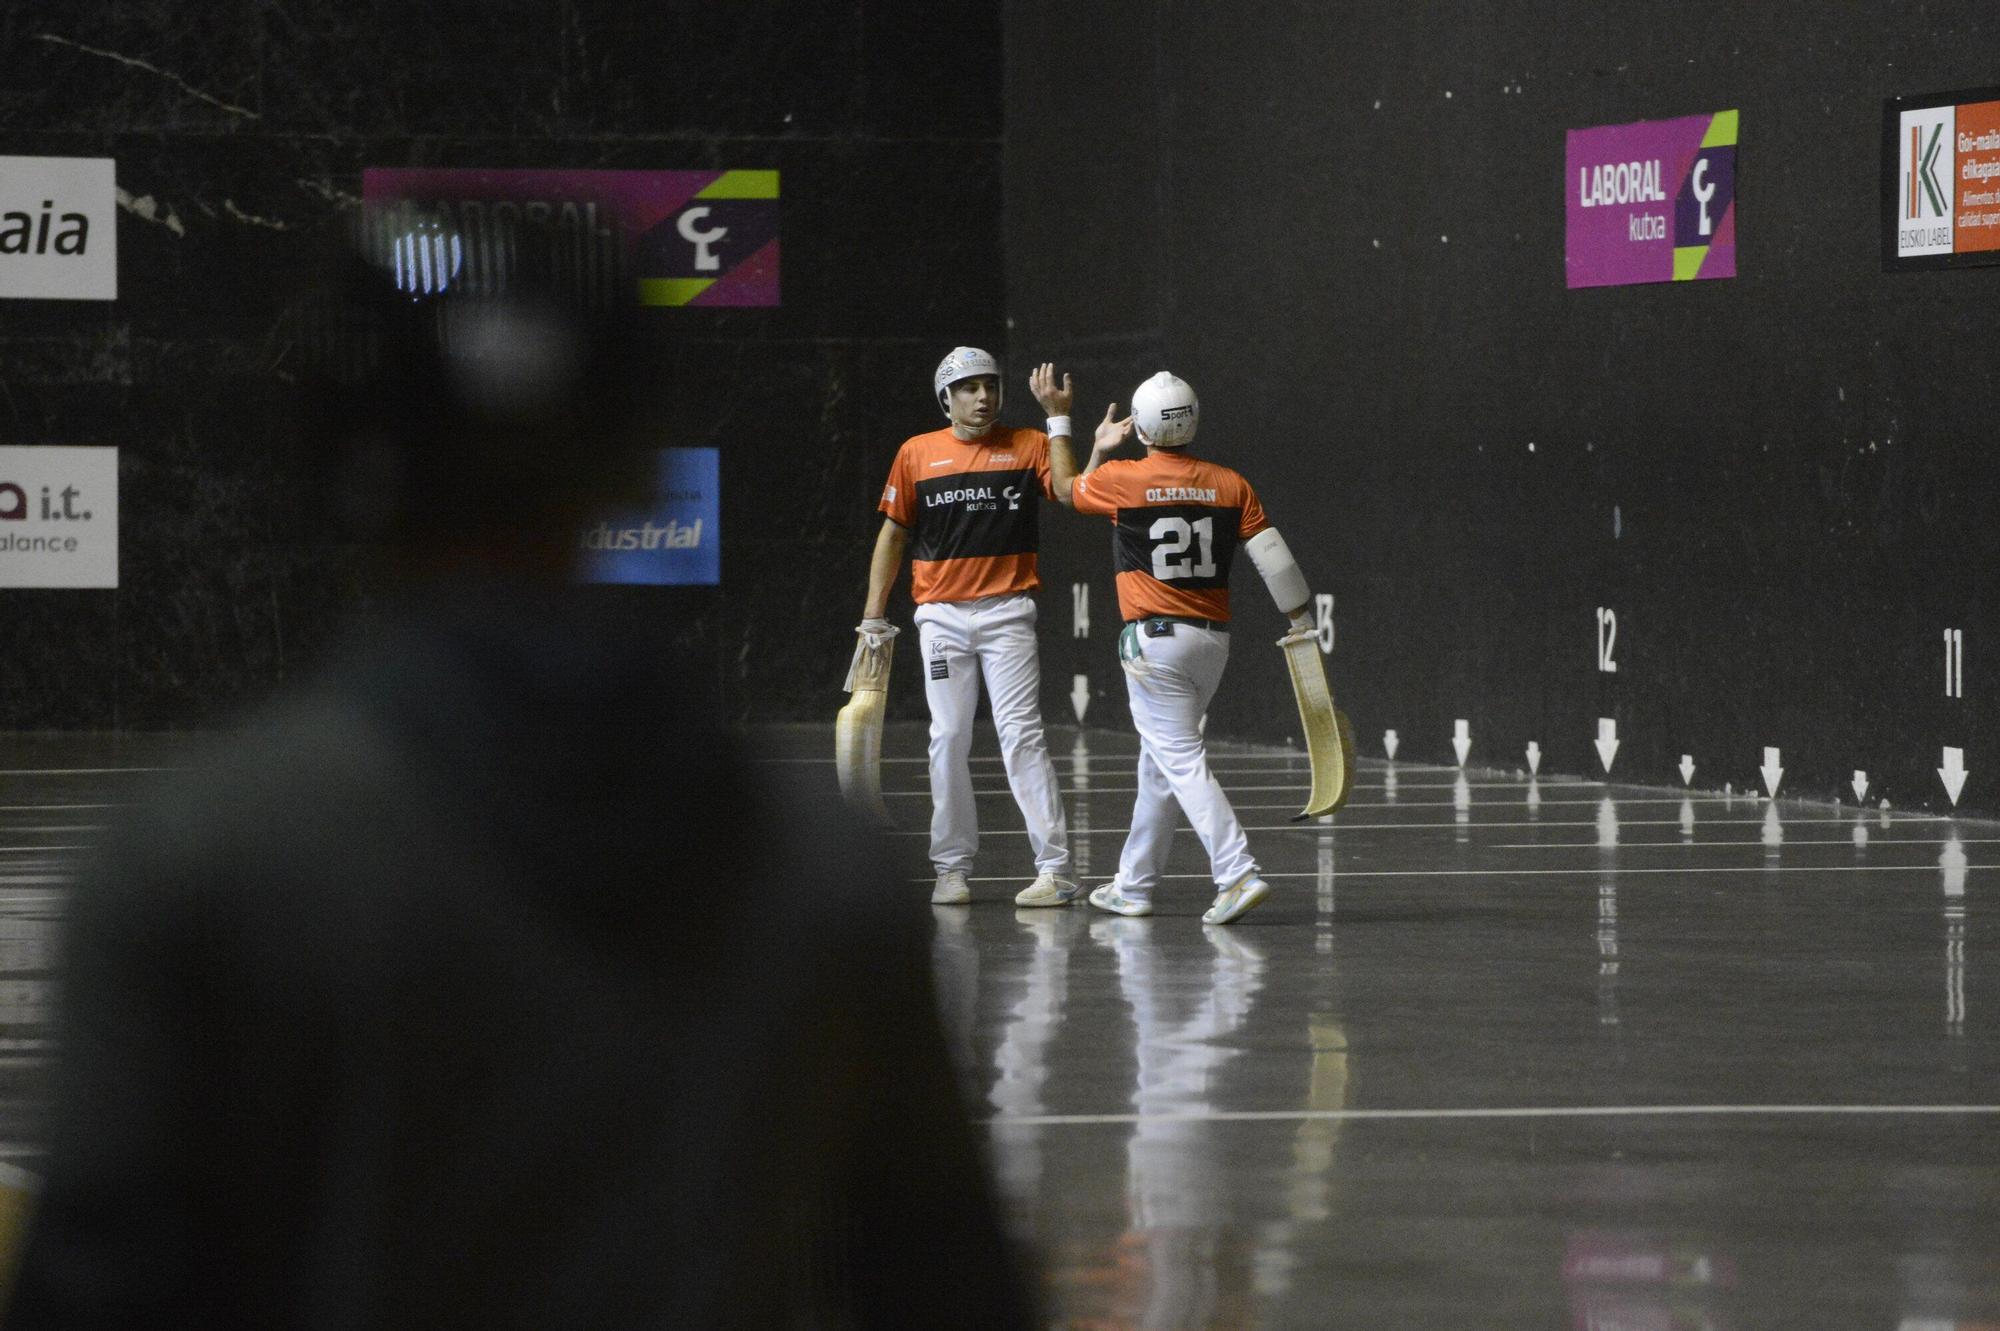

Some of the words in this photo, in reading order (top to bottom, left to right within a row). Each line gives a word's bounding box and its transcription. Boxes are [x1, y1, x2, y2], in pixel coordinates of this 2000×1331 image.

[1580, 159, 1666, 208] LABORAL
[0, 200, 89, 256] aia
[1629, 212, 1665, 241] kutxa
[1900, 228, 1925, 249] EUSKO
[1927, 226, 1951, 247] LABEL
[41, 485, 92, 520] i.t.
[926, 487, 997, 508] LABORAL
[966, 502, 997, 512] kutxa
[1145, 487, 1216, 502] OLHARAN
[1149, 516, 1217, 581] 21
[1597, 607, 1617, 672] 12
[1943, 628, 1962, 698] 11
